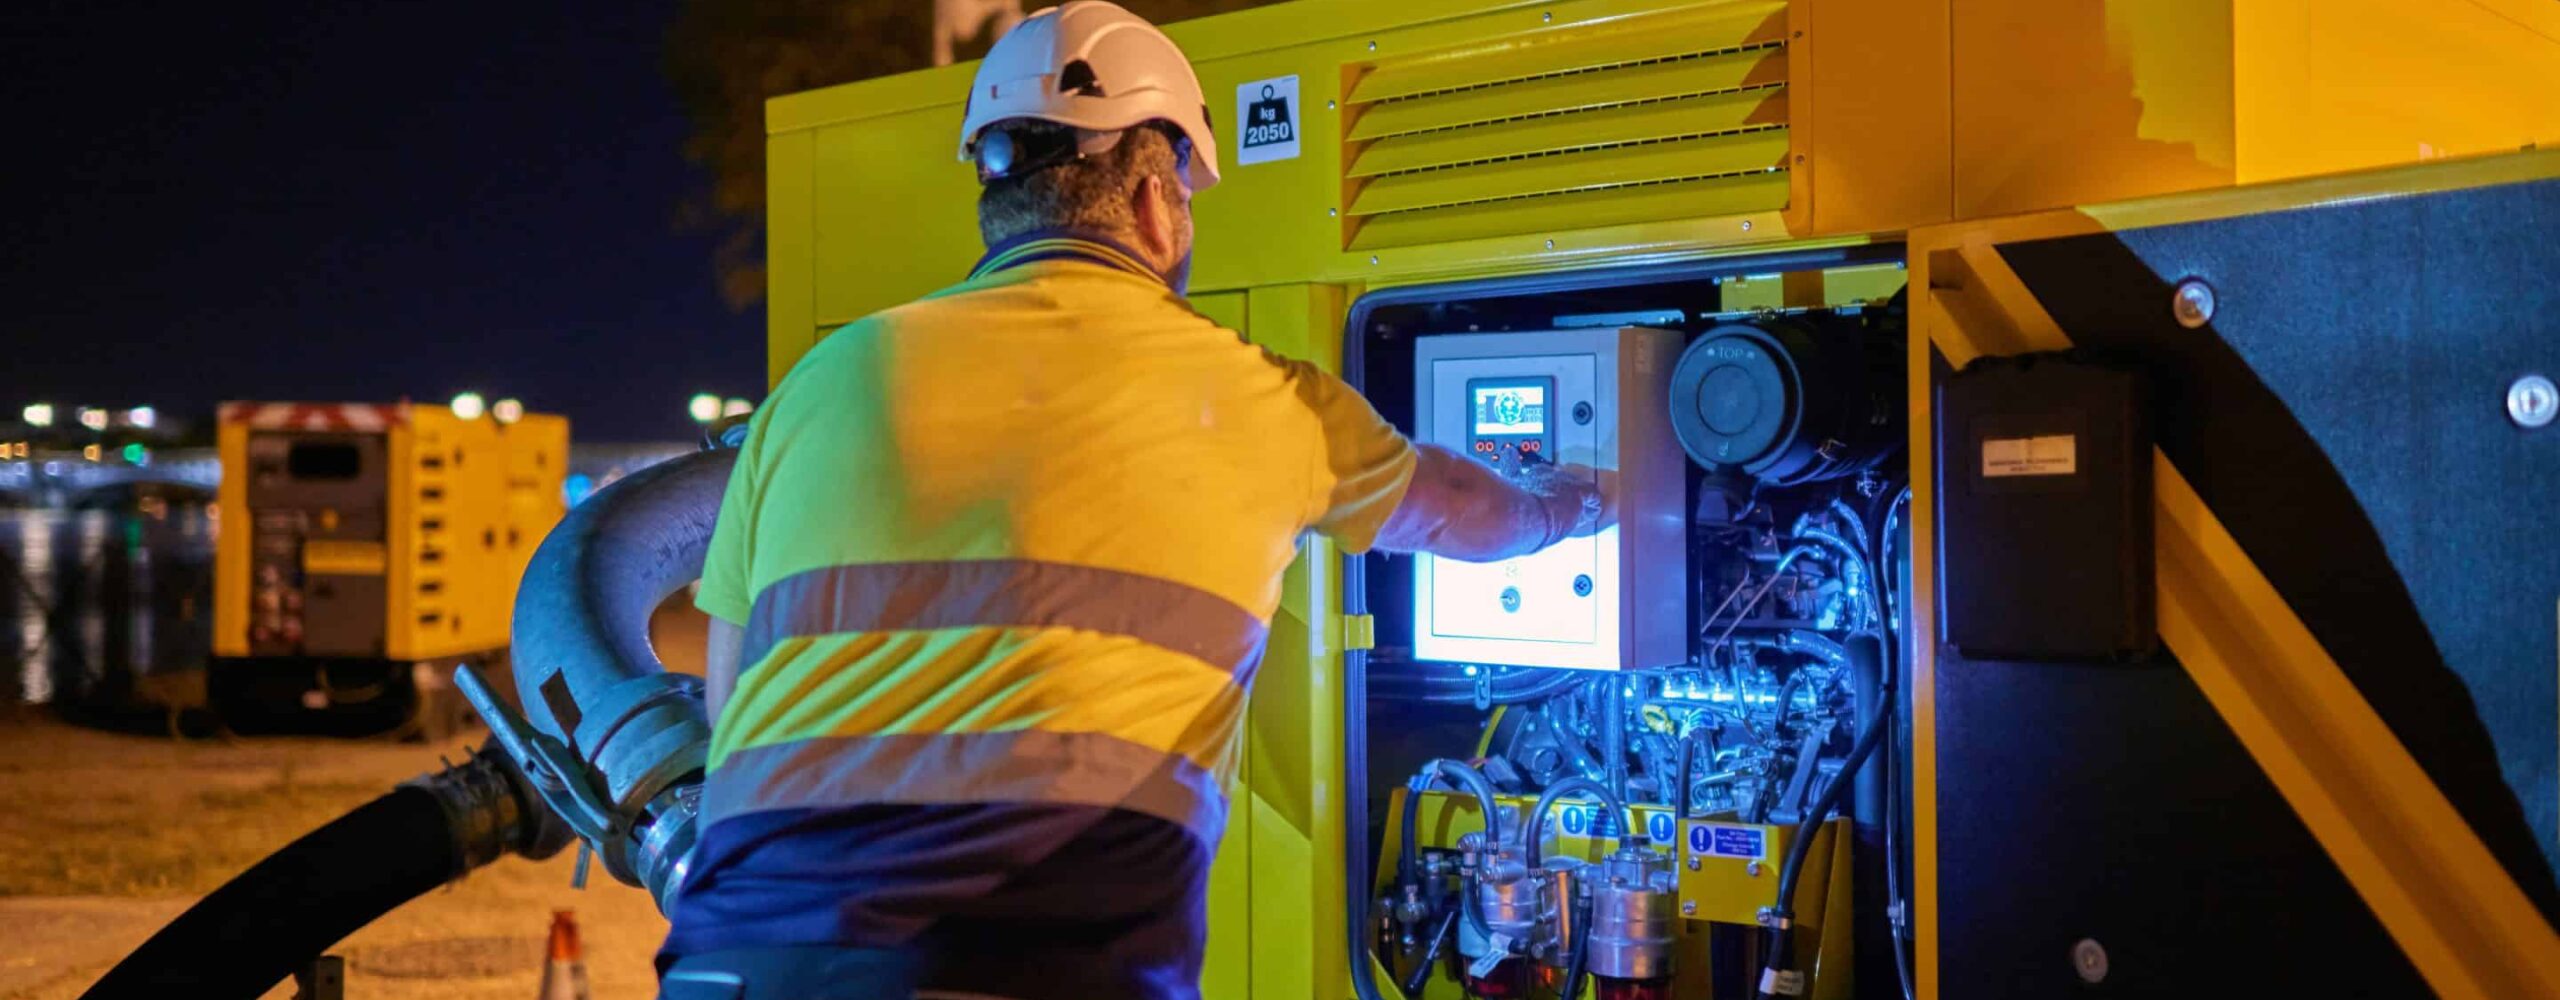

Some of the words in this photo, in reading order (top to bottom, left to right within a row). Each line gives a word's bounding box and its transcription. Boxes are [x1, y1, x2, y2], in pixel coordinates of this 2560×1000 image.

[1260, 108, 1276, 120] kg
[1247, 123, 1289, 144] 2050
[1719, 346, 1744, 359] TOP
